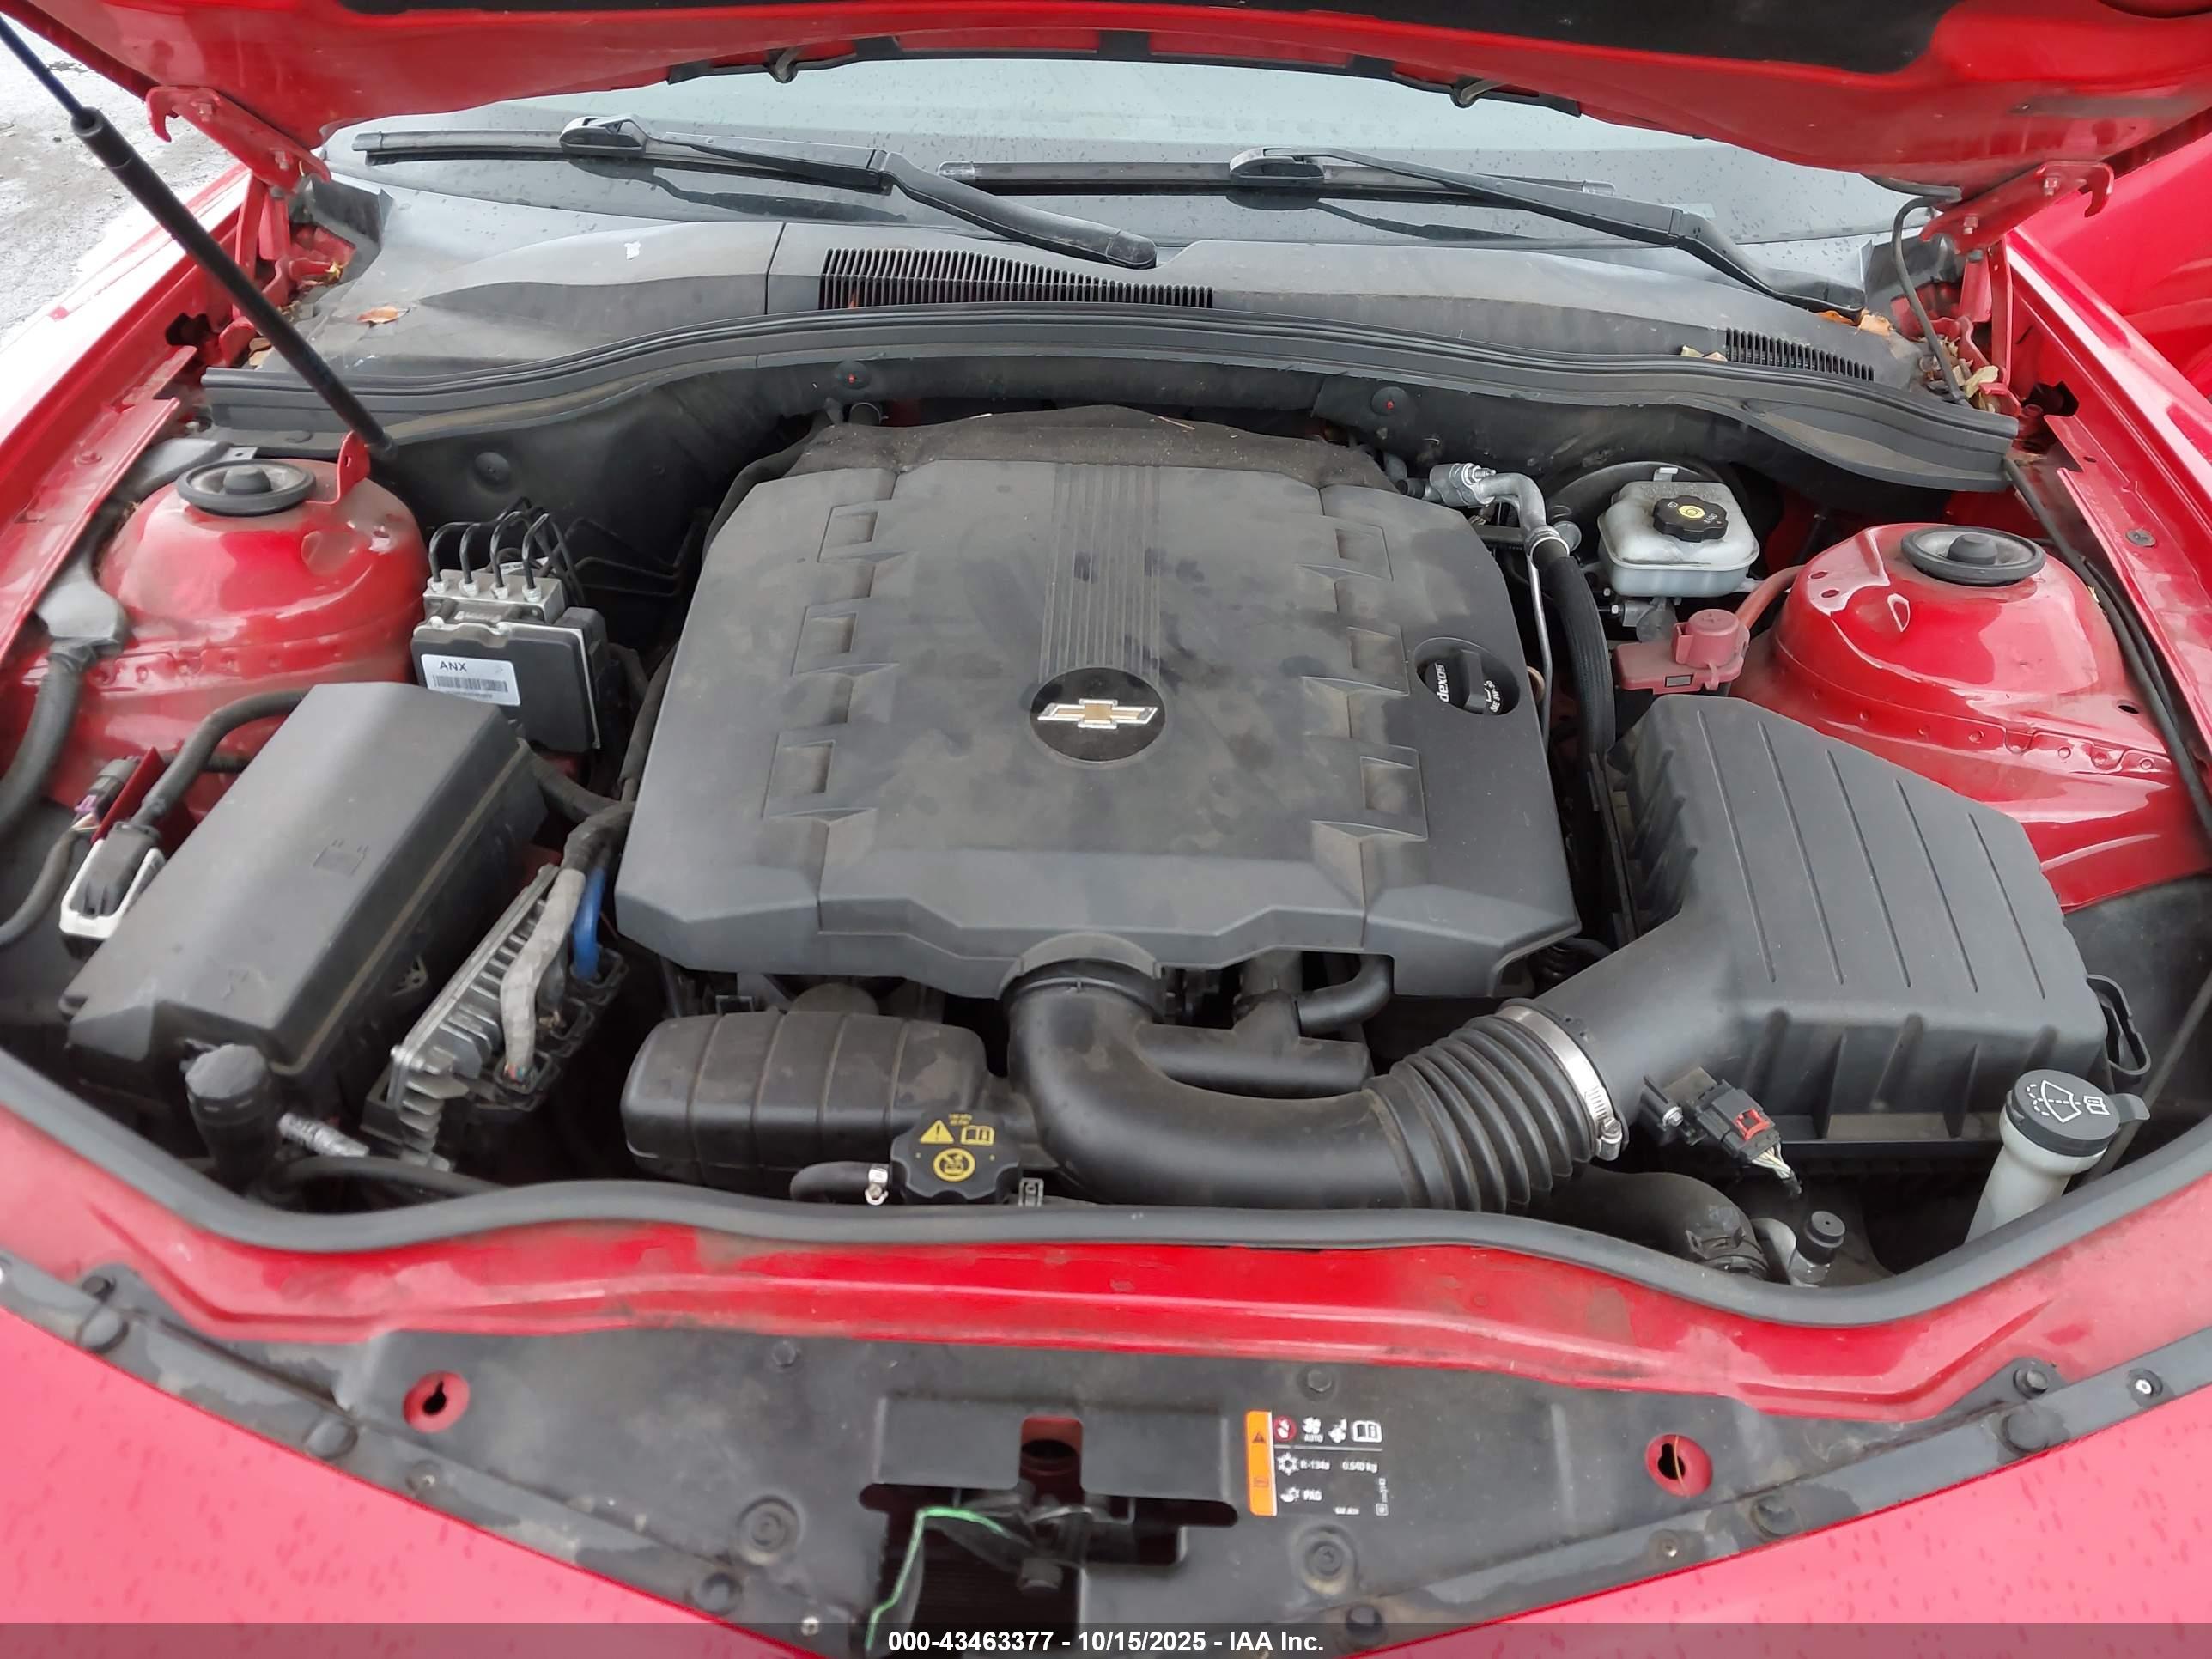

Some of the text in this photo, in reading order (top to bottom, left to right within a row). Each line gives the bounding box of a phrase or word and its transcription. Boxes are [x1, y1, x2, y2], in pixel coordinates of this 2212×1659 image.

[439, 660, 467, 672] ANX
[1434, 661, 1449, 702] dexos
[1304, 1433, 1324, 1443] AUTO
[1300, 1460, 1330, 1471] R-134a
[1365, 1462, 1378, 1474] kg
[1303, 1488, 1322, 1501] PAG
